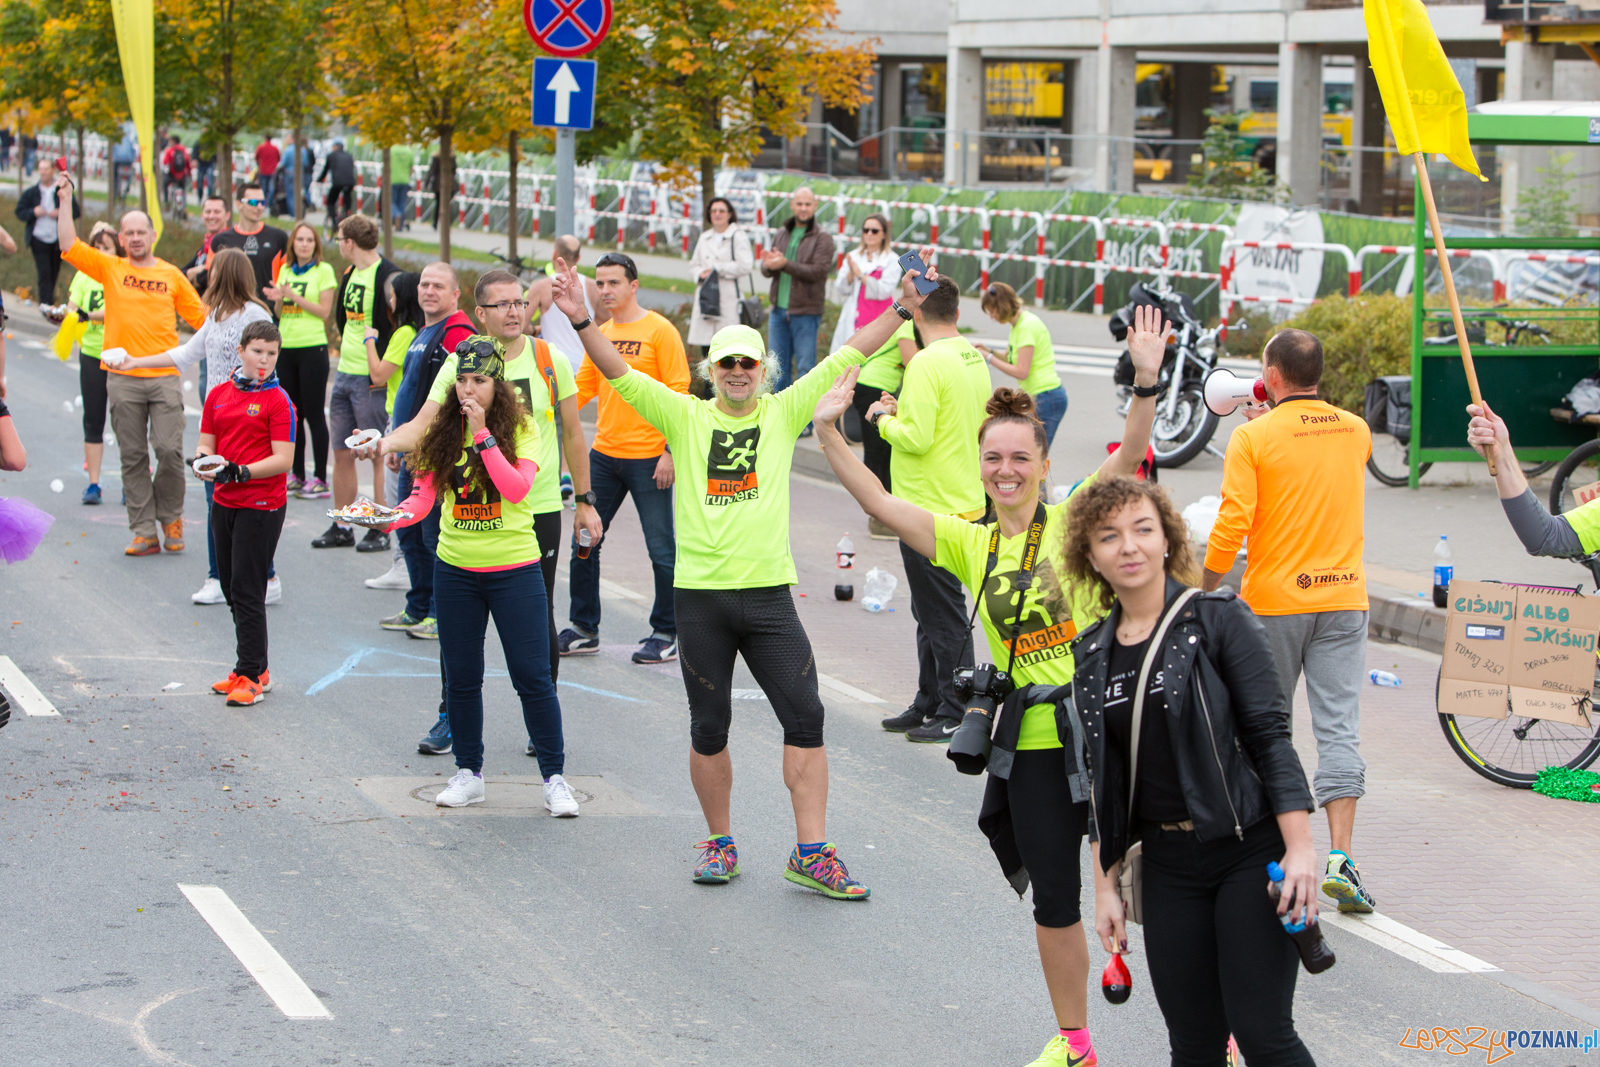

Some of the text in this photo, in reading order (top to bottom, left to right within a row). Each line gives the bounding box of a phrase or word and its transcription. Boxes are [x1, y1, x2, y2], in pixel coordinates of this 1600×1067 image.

[461, 505, 493, 519] night
[452, 517, 503, 531] runners
[1023, 522, 1043, 571] Nikon D610
[1455, 594, 1569, 622] CIŚNIJ ALBO
[1020, 624, 1066, 649] night
[1524, 626, 1595, 652] SKIŚNIJ
[1482, 659, 1505, 676] 3262
[1523, 657, 1549, 671] DORKA
[1456, 688, 1484, 699] MATTE
[1525, 699, 1547, 708] OWCA
